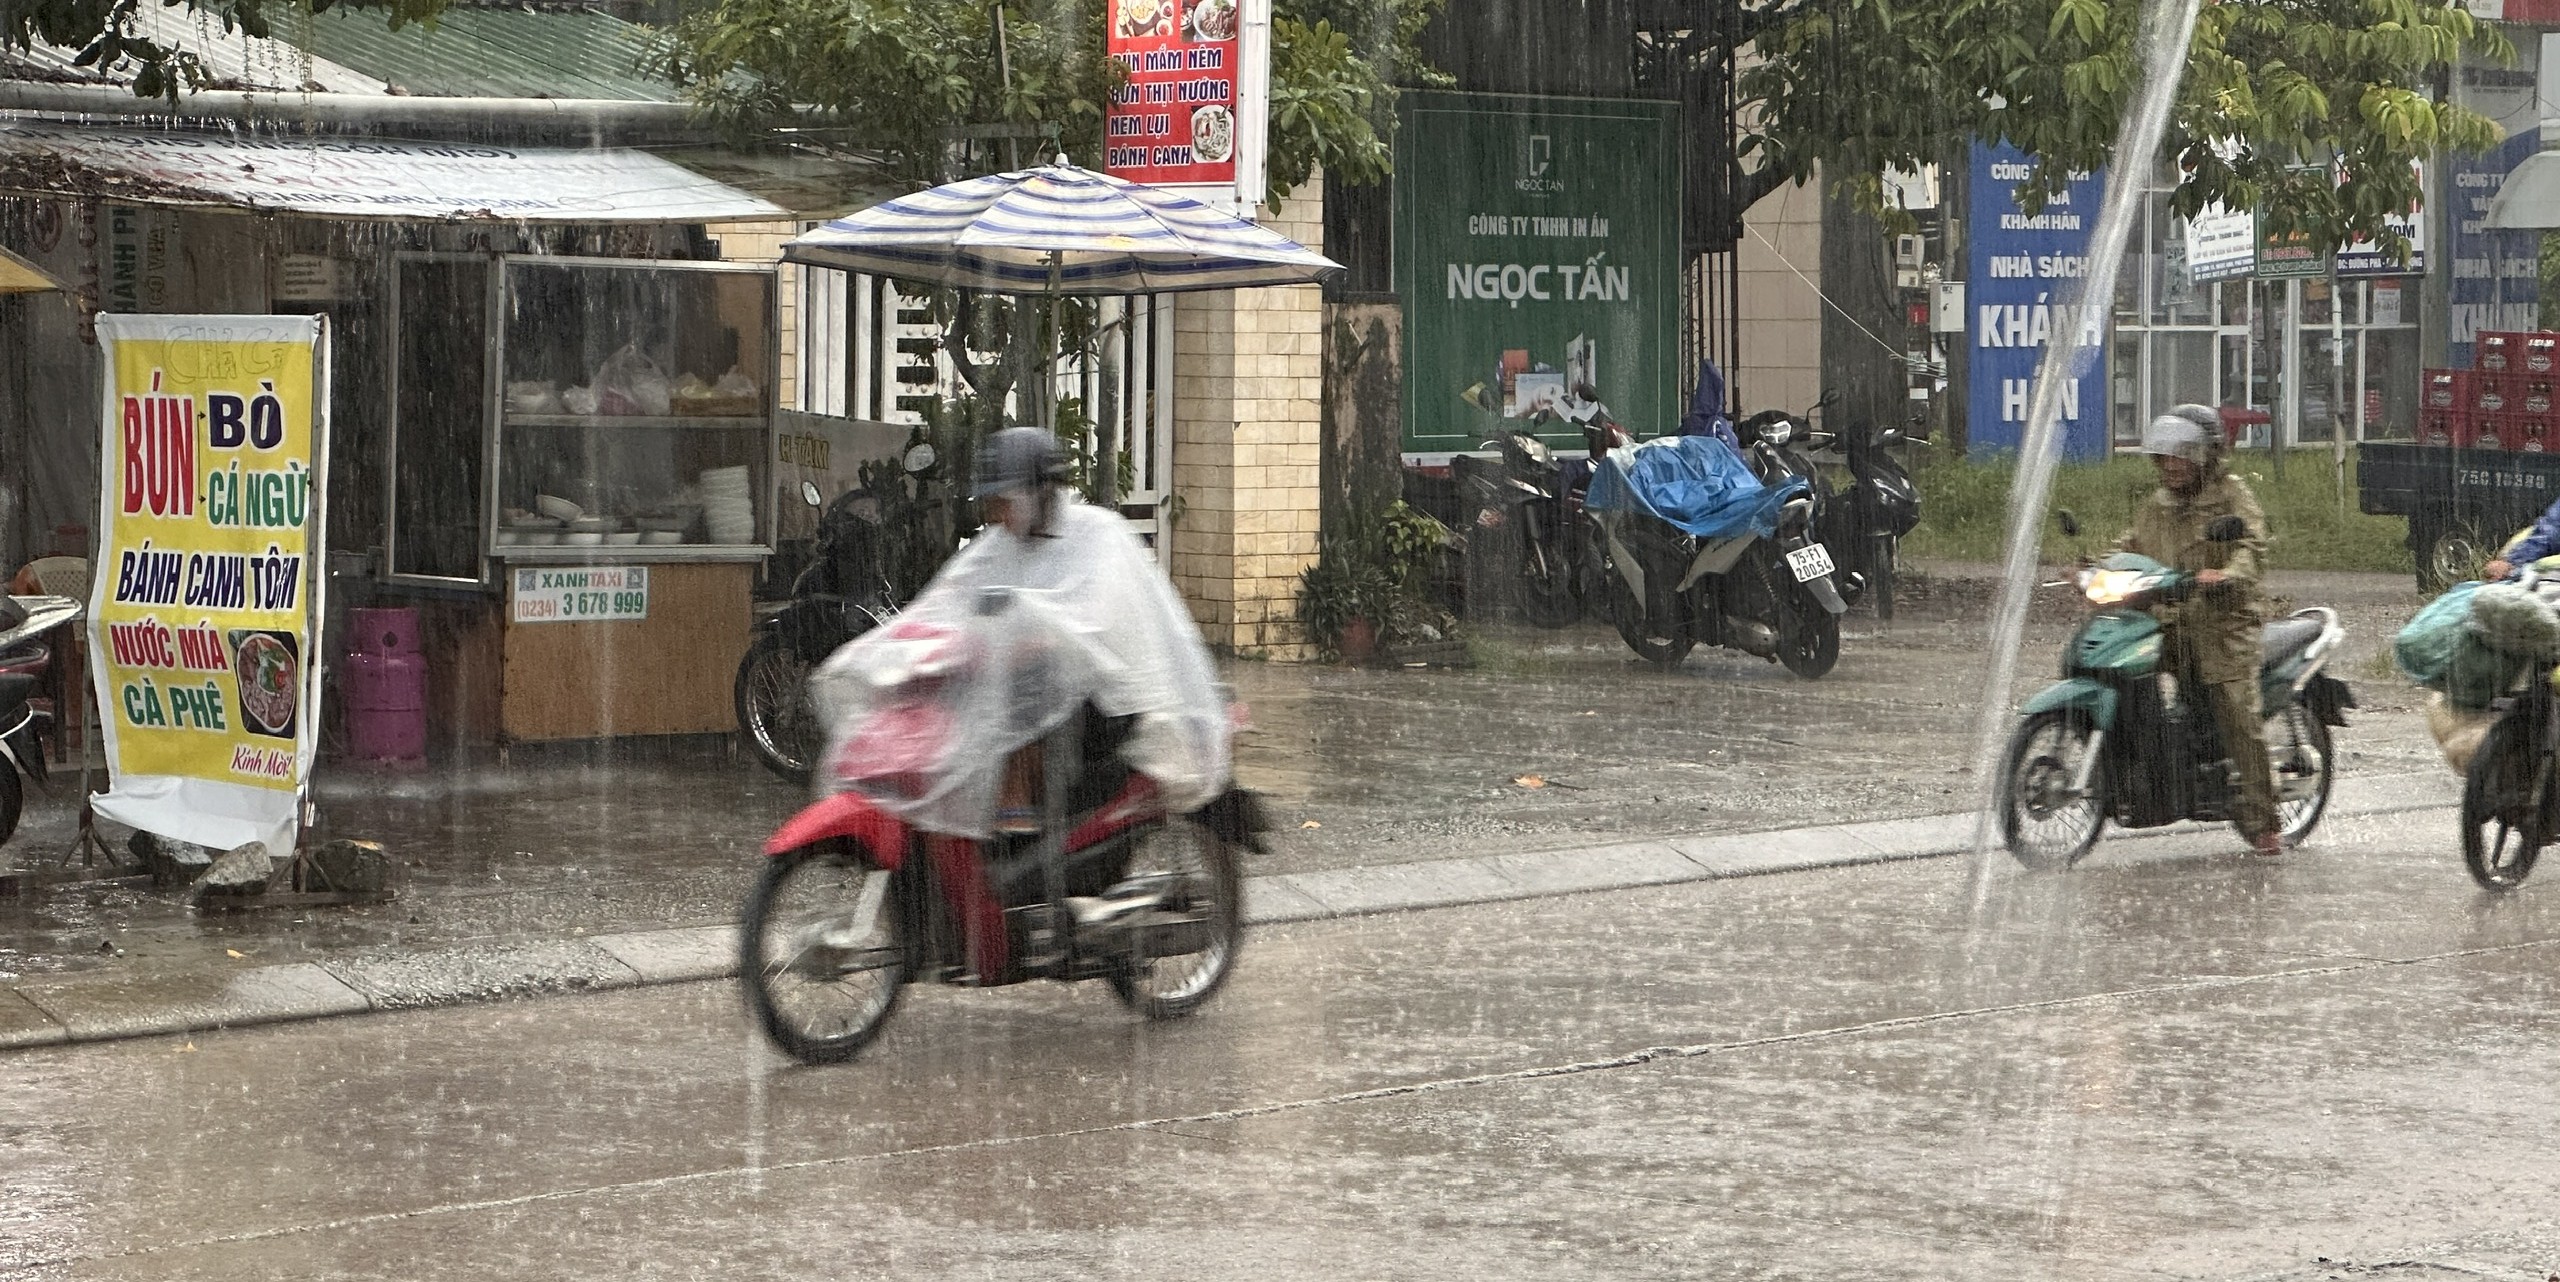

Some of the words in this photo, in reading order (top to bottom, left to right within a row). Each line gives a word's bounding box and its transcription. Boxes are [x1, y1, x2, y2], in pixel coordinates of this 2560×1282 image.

[1145, 45, 1182, 71] MẮM
[1188, 46, 1223, 69] NÊM
[1145, 82, 1174, 107] THỊT
[1178, 77, 1230, 101] NƯỚNG
[1110, 115, 1142, 136] NEM
[1147, 114, 1170, 139] LỤI
[1109, 144, 1147, 168] BÁNH
[1152, 145, 1192, 167] CANH
[1991, 159, 2030, 181] CÔNG
[2456, 169, 2489, 188] CÔNG
[1469, 212, 1508, 236] CÔNG
[1511, 216, 1528, 236] TY
[1532, 217, 1568, 236] TNHH
[1572, 218, 1587, 237] IN
[2051, 211, 2081, 230] HÂN
[1990, 250, 2033, 278] NHÀ
[2038, 250, 2090, 278] SÁCH
[1447, 263, 1550, 309] NGỌC
[1557, 252, 1629, 300] TẤN
[1979, 292, 2101, 347] KHÁNH
[208, 382, 283, 449] BÒ
[124, 371, 194, 516] BÚN
[208, 461, 240, 525] CÁ
[245, 461, 310, 527] NGỪ
[115, 541, 183, 605] BÁNH
[184, 553, 245, 608] CANH
[250, 546, 301, 609] TÔM
[517, 599, 557, 619] (0234)
[563, 593, 573, 616] 3
[578, 592, 609, 616] 678
[613, 591, 644, 614] 999
[110, 618, 175, 668] NƯỚC
[177, 620, 228, 671] MÍA
[123, 677, 166, 727] CÀ
[168, 681, 226, 730] PHÊ
[231, 746, 262, 772] Kính
